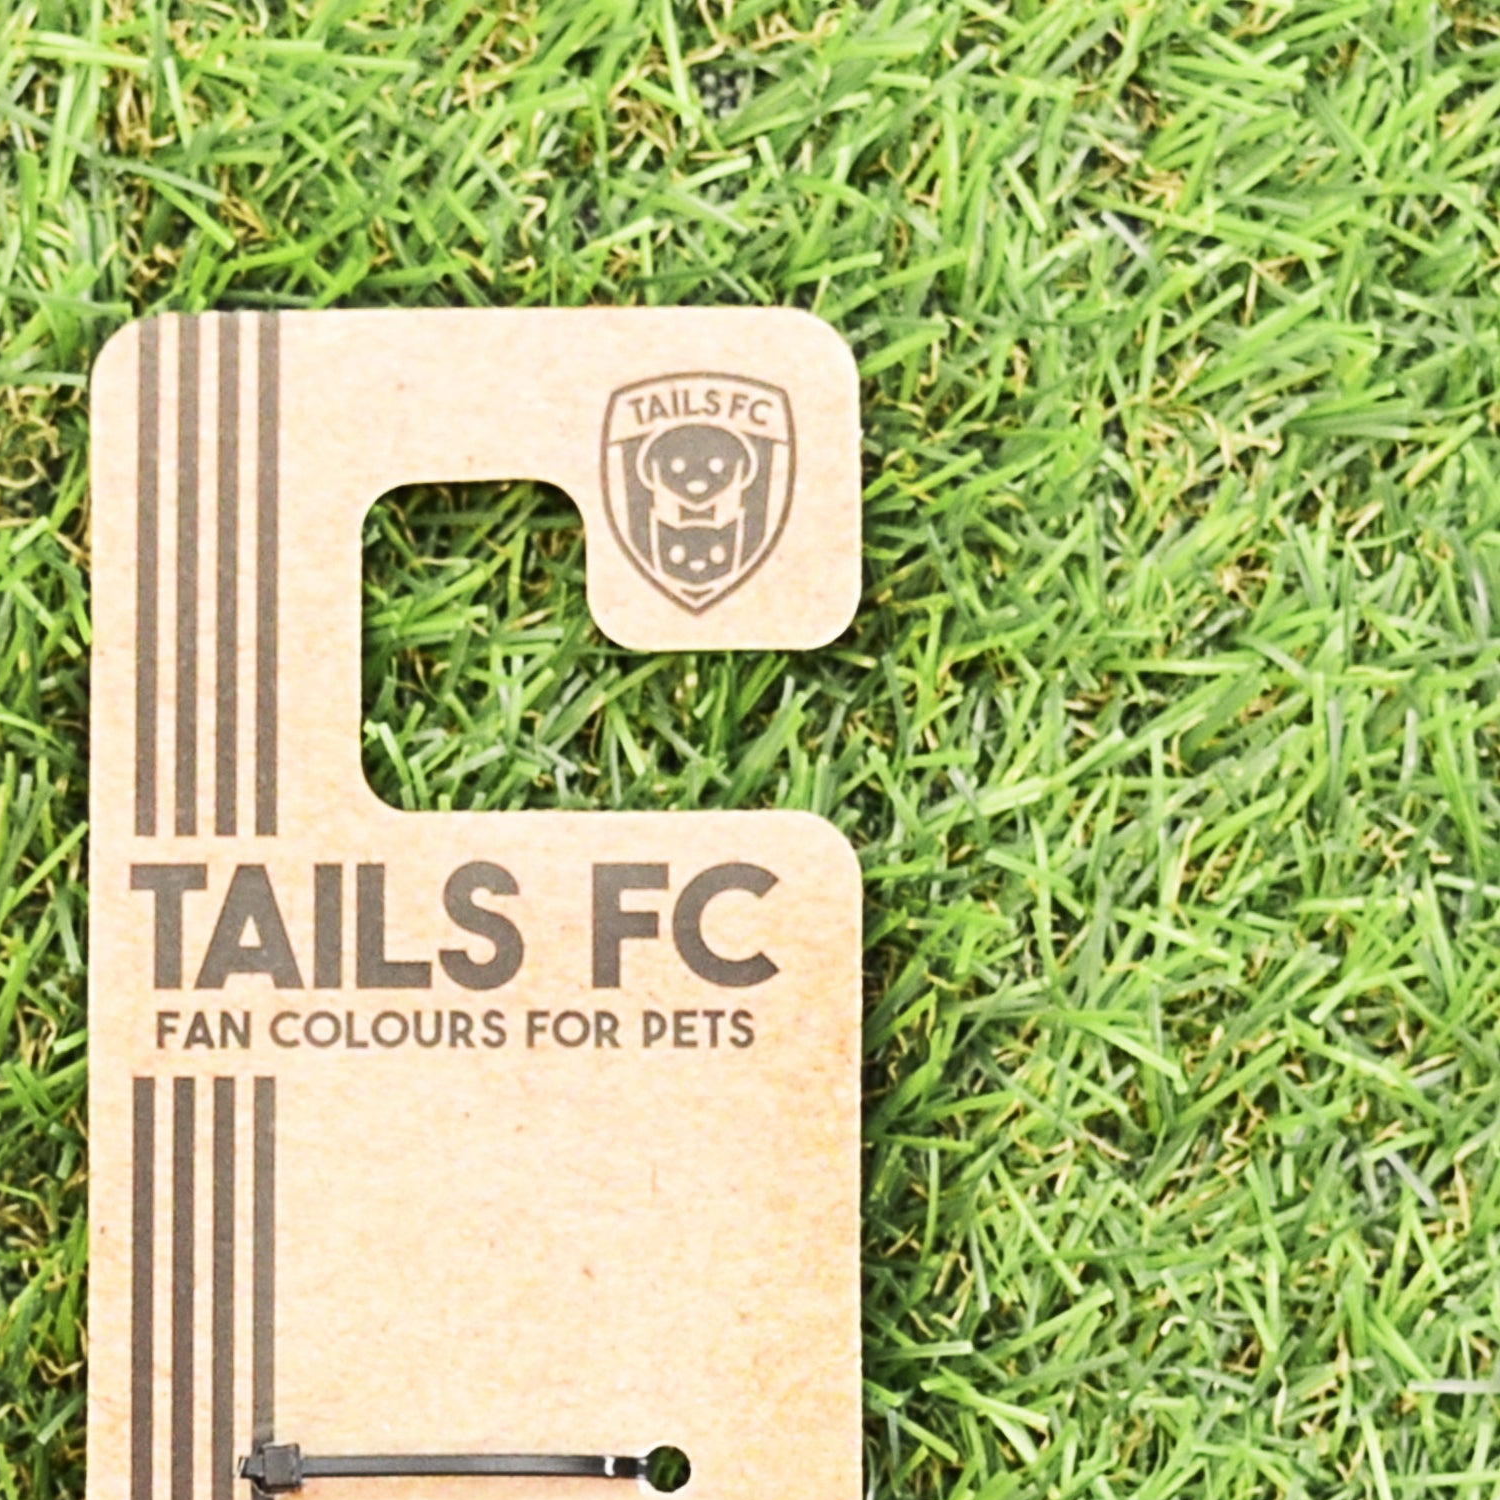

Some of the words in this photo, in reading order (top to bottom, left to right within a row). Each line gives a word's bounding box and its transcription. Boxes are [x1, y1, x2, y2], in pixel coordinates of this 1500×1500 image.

[627, 388, 721, 425] TAILS
[728, 392, 774, 426] FC
[130, 861, 525, 991] TAILS
[591, 862, 780, 988] FC
[156, 1010, 252, 1049] FAN
[269, 1010, 508, 1050] COLOURS
[526, 1011, 621, 1049] FOR
[643, 1011, 756, 1050] PETS
